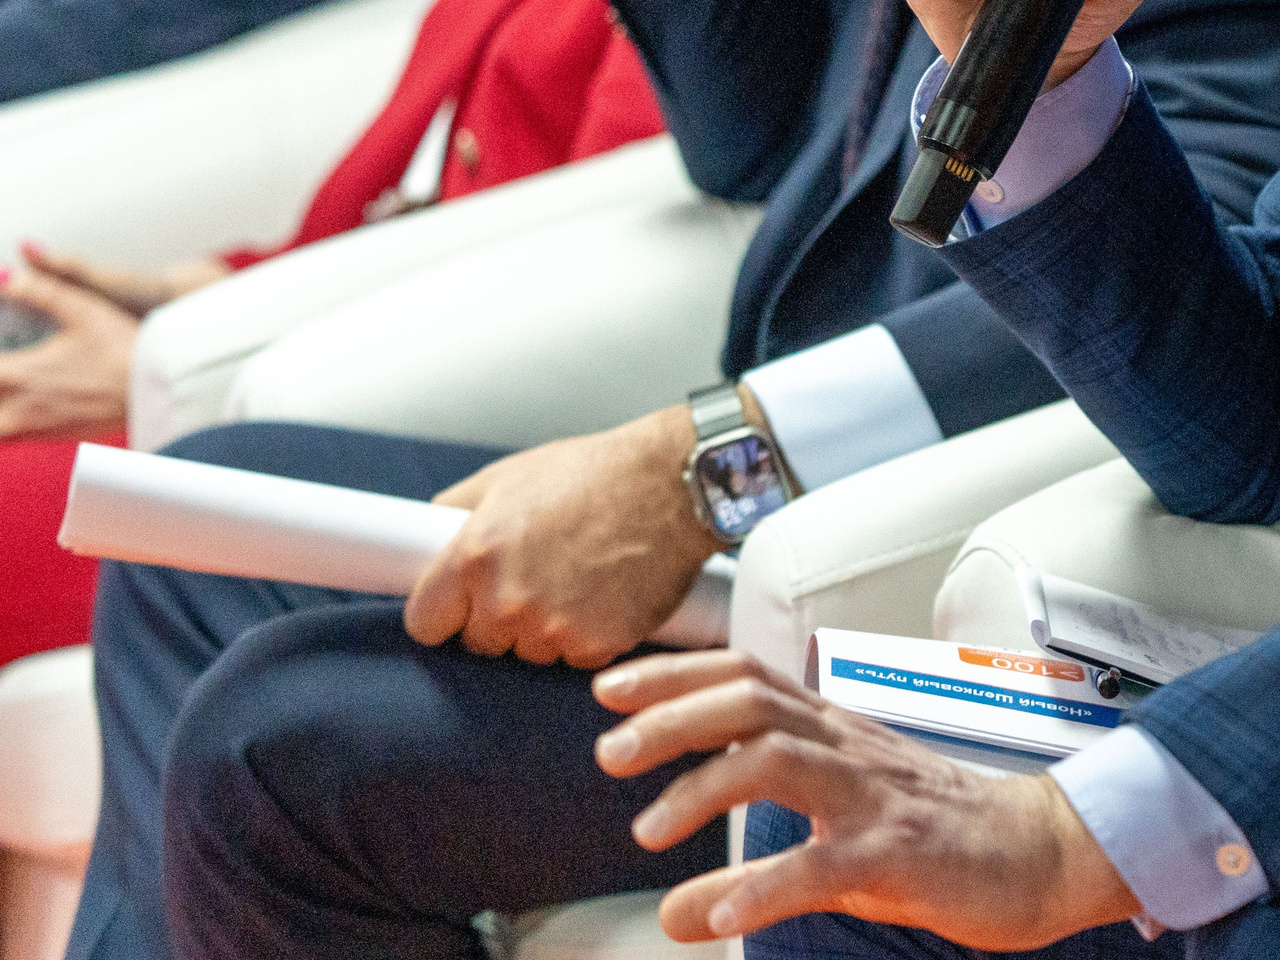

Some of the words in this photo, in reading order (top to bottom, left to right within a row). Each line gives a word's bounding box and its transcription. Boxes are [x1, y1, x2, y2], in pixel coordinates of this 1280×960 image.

[855, 668, 908, 683] путь»
[913, 678, 1014, 704] Шелковый
[1018, 697, 1092, 717] «Новый
